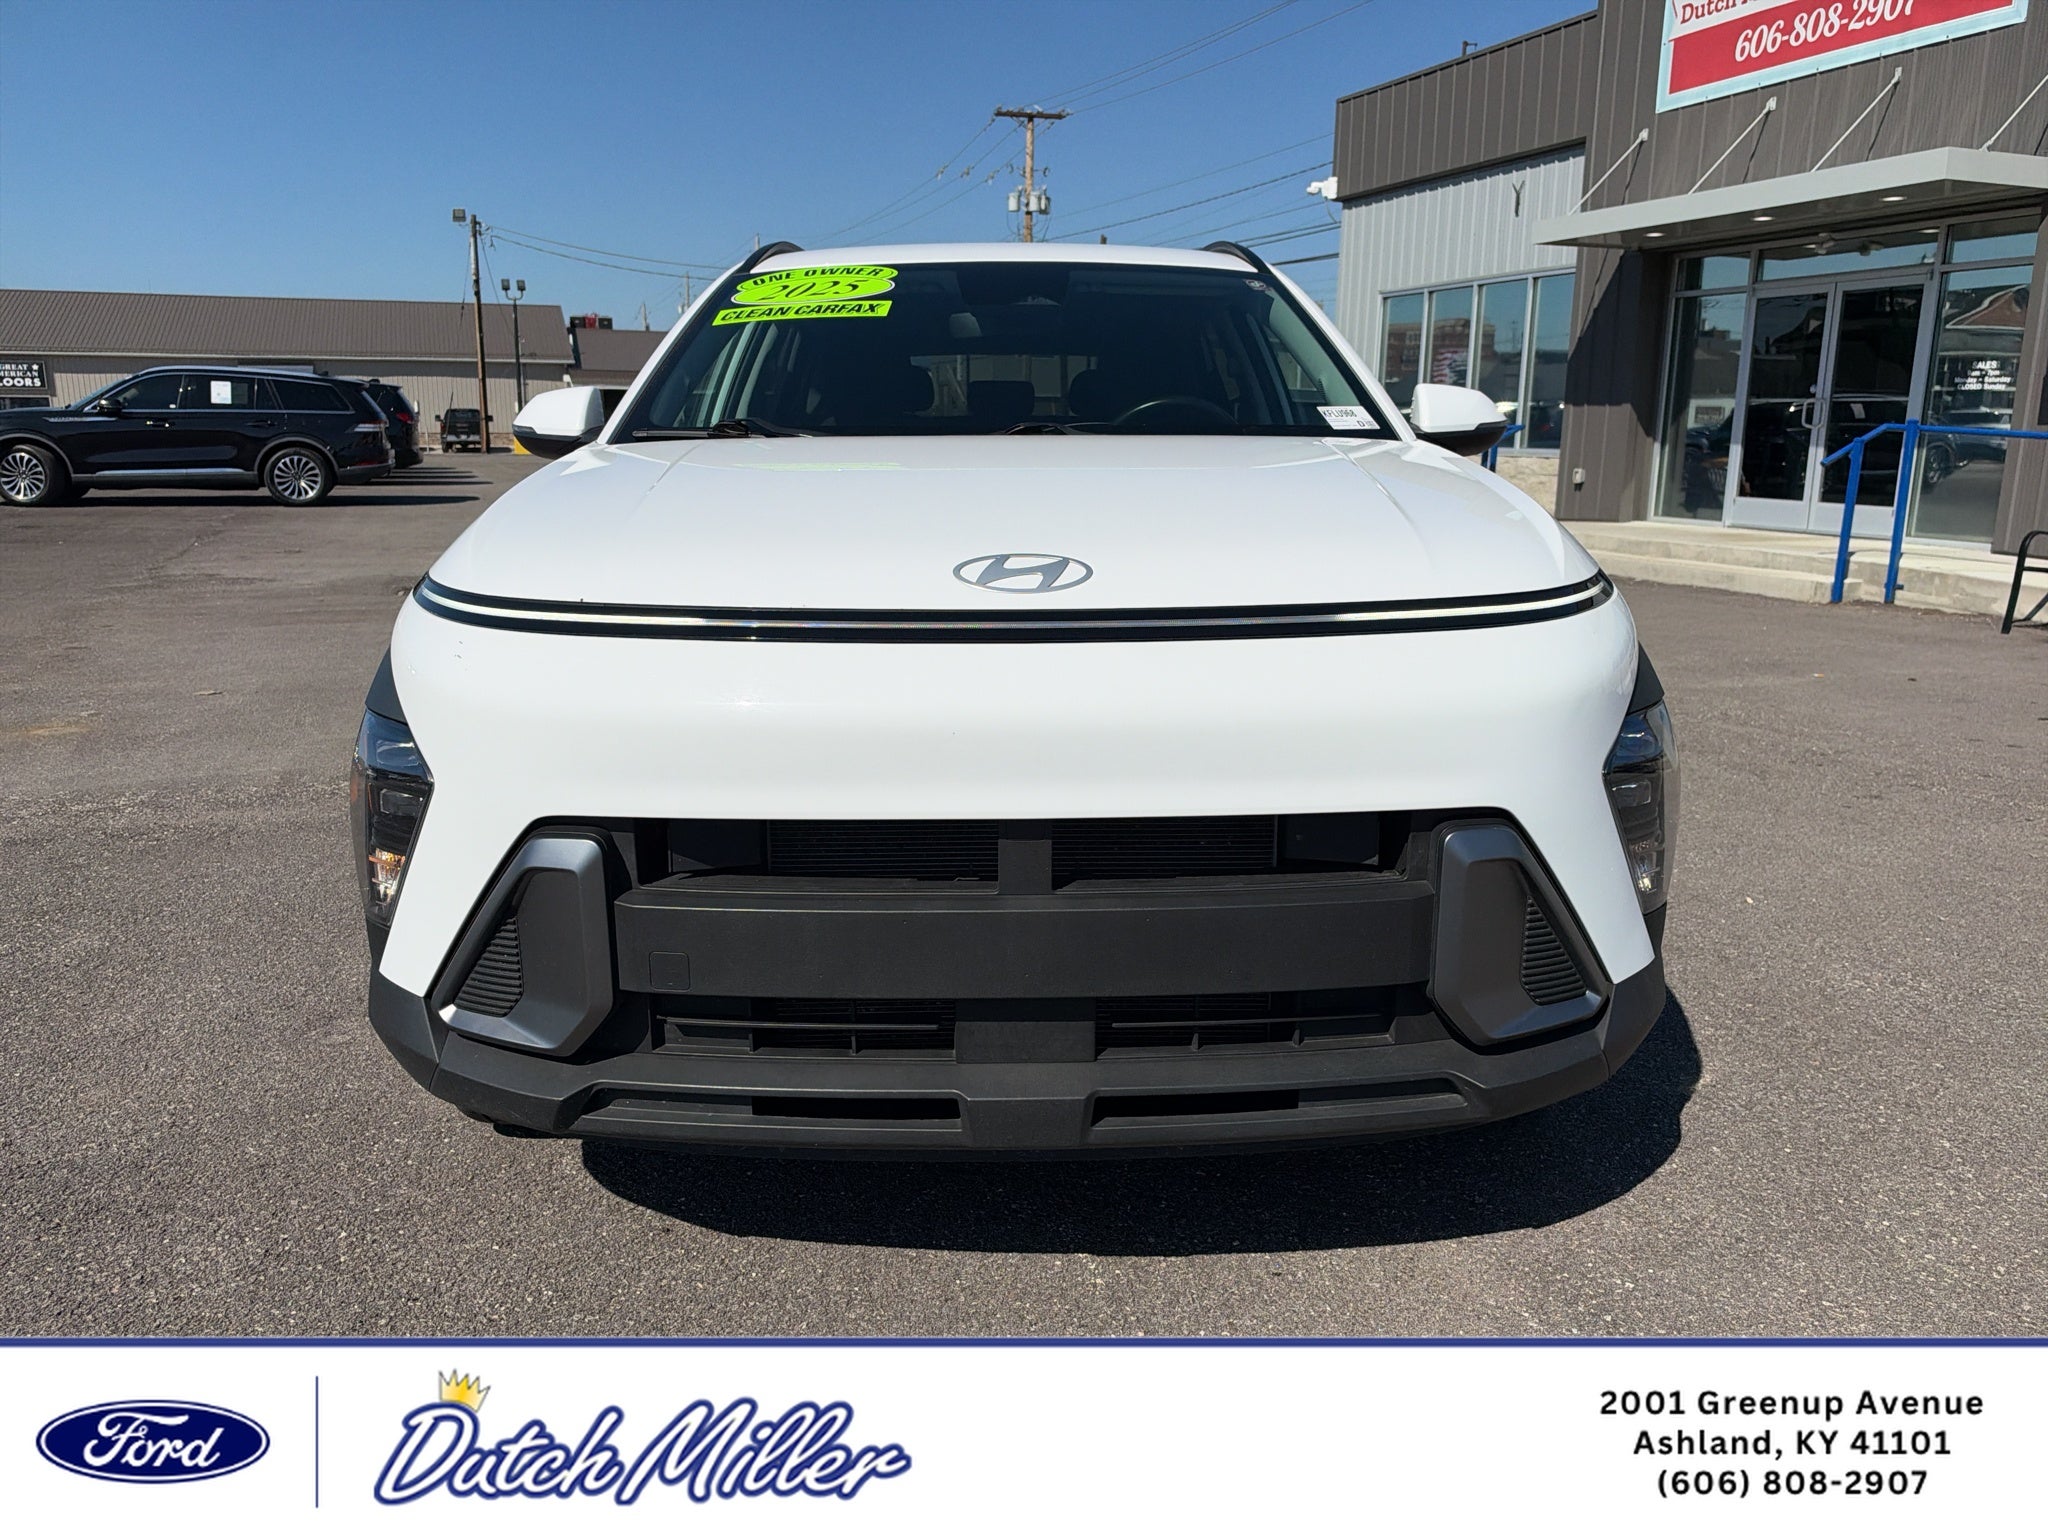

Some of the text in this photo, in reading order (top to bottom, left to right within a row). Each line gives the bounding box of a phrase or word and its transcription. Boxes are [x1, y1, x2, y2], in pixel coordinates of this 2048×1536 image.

[753, 267, 881, 286] ONE OWNER
[757, 280, 868, 300] 2025
[721, 303, 880, 321] CLEAN CARFAX
[1972, 360, 1998, 369] SALES
[0, 377, 41, 386] OORS
